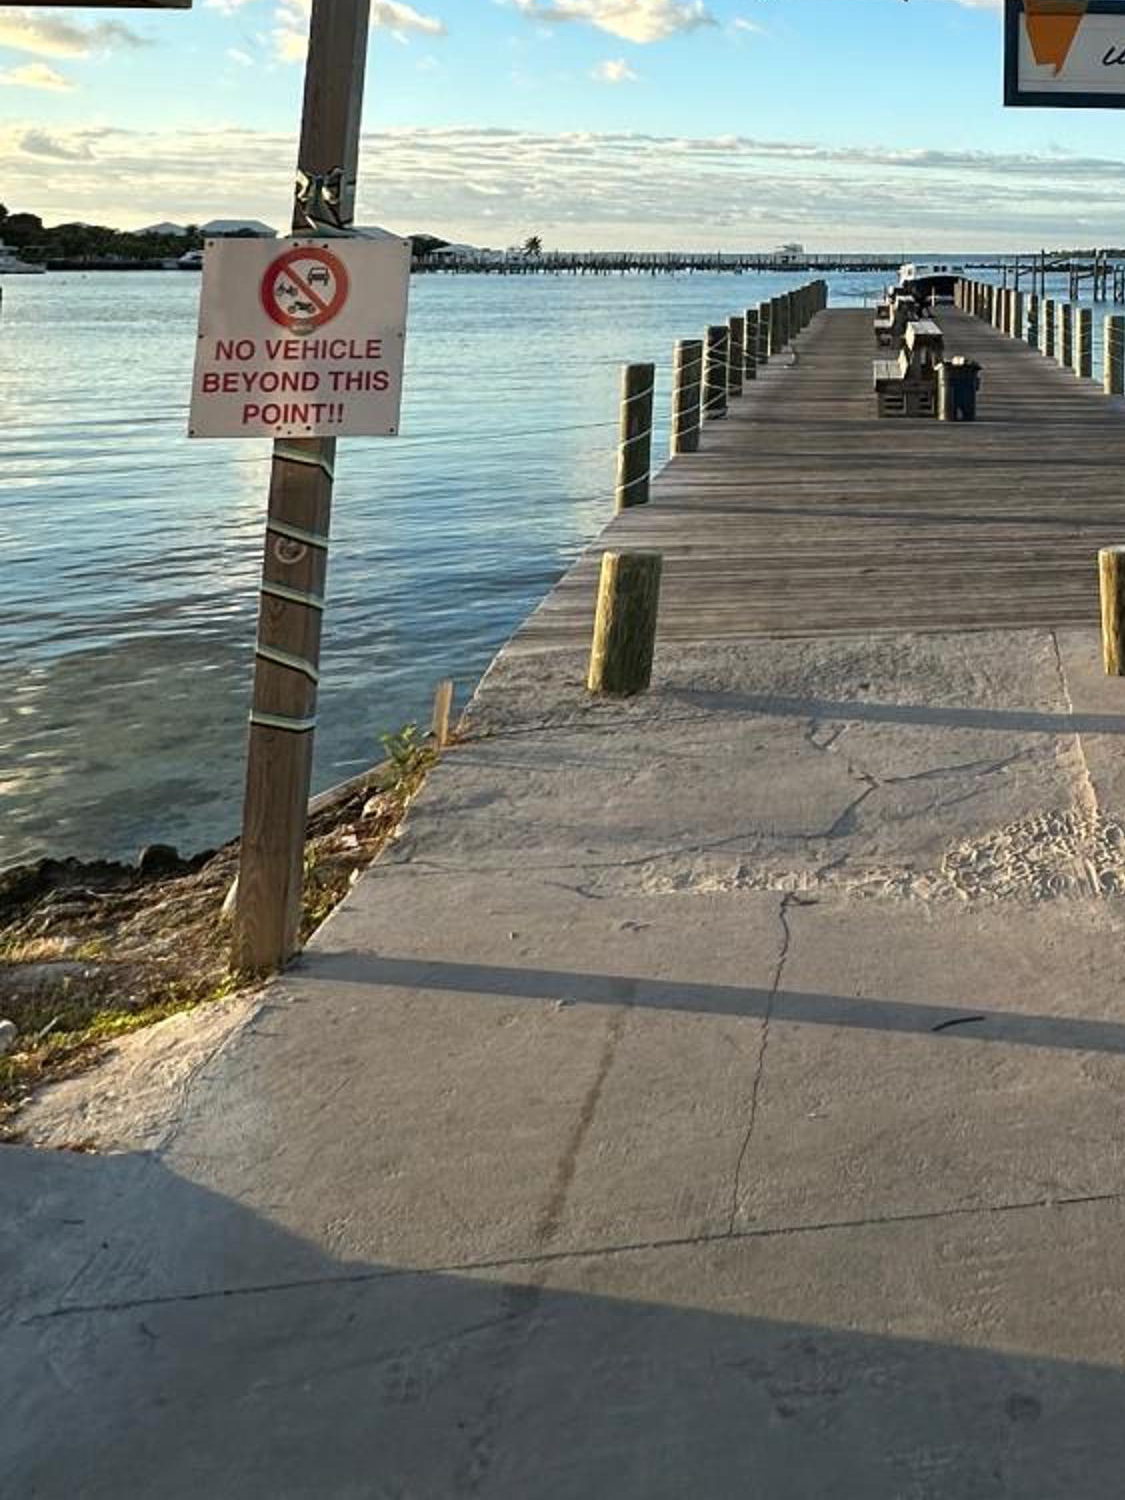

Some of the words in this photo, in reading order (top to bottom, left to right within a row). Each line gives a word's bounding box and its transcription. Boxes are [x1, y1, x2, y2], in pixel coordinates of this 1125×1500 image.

[215, 340, 256, 361] NO
[266, 339, 383, 361] VEHICLE
[202, 371, 319, 393] BEYOND
[328, 371, 389, 392] THIS
[242, 403, 344, 424] POINT!!
